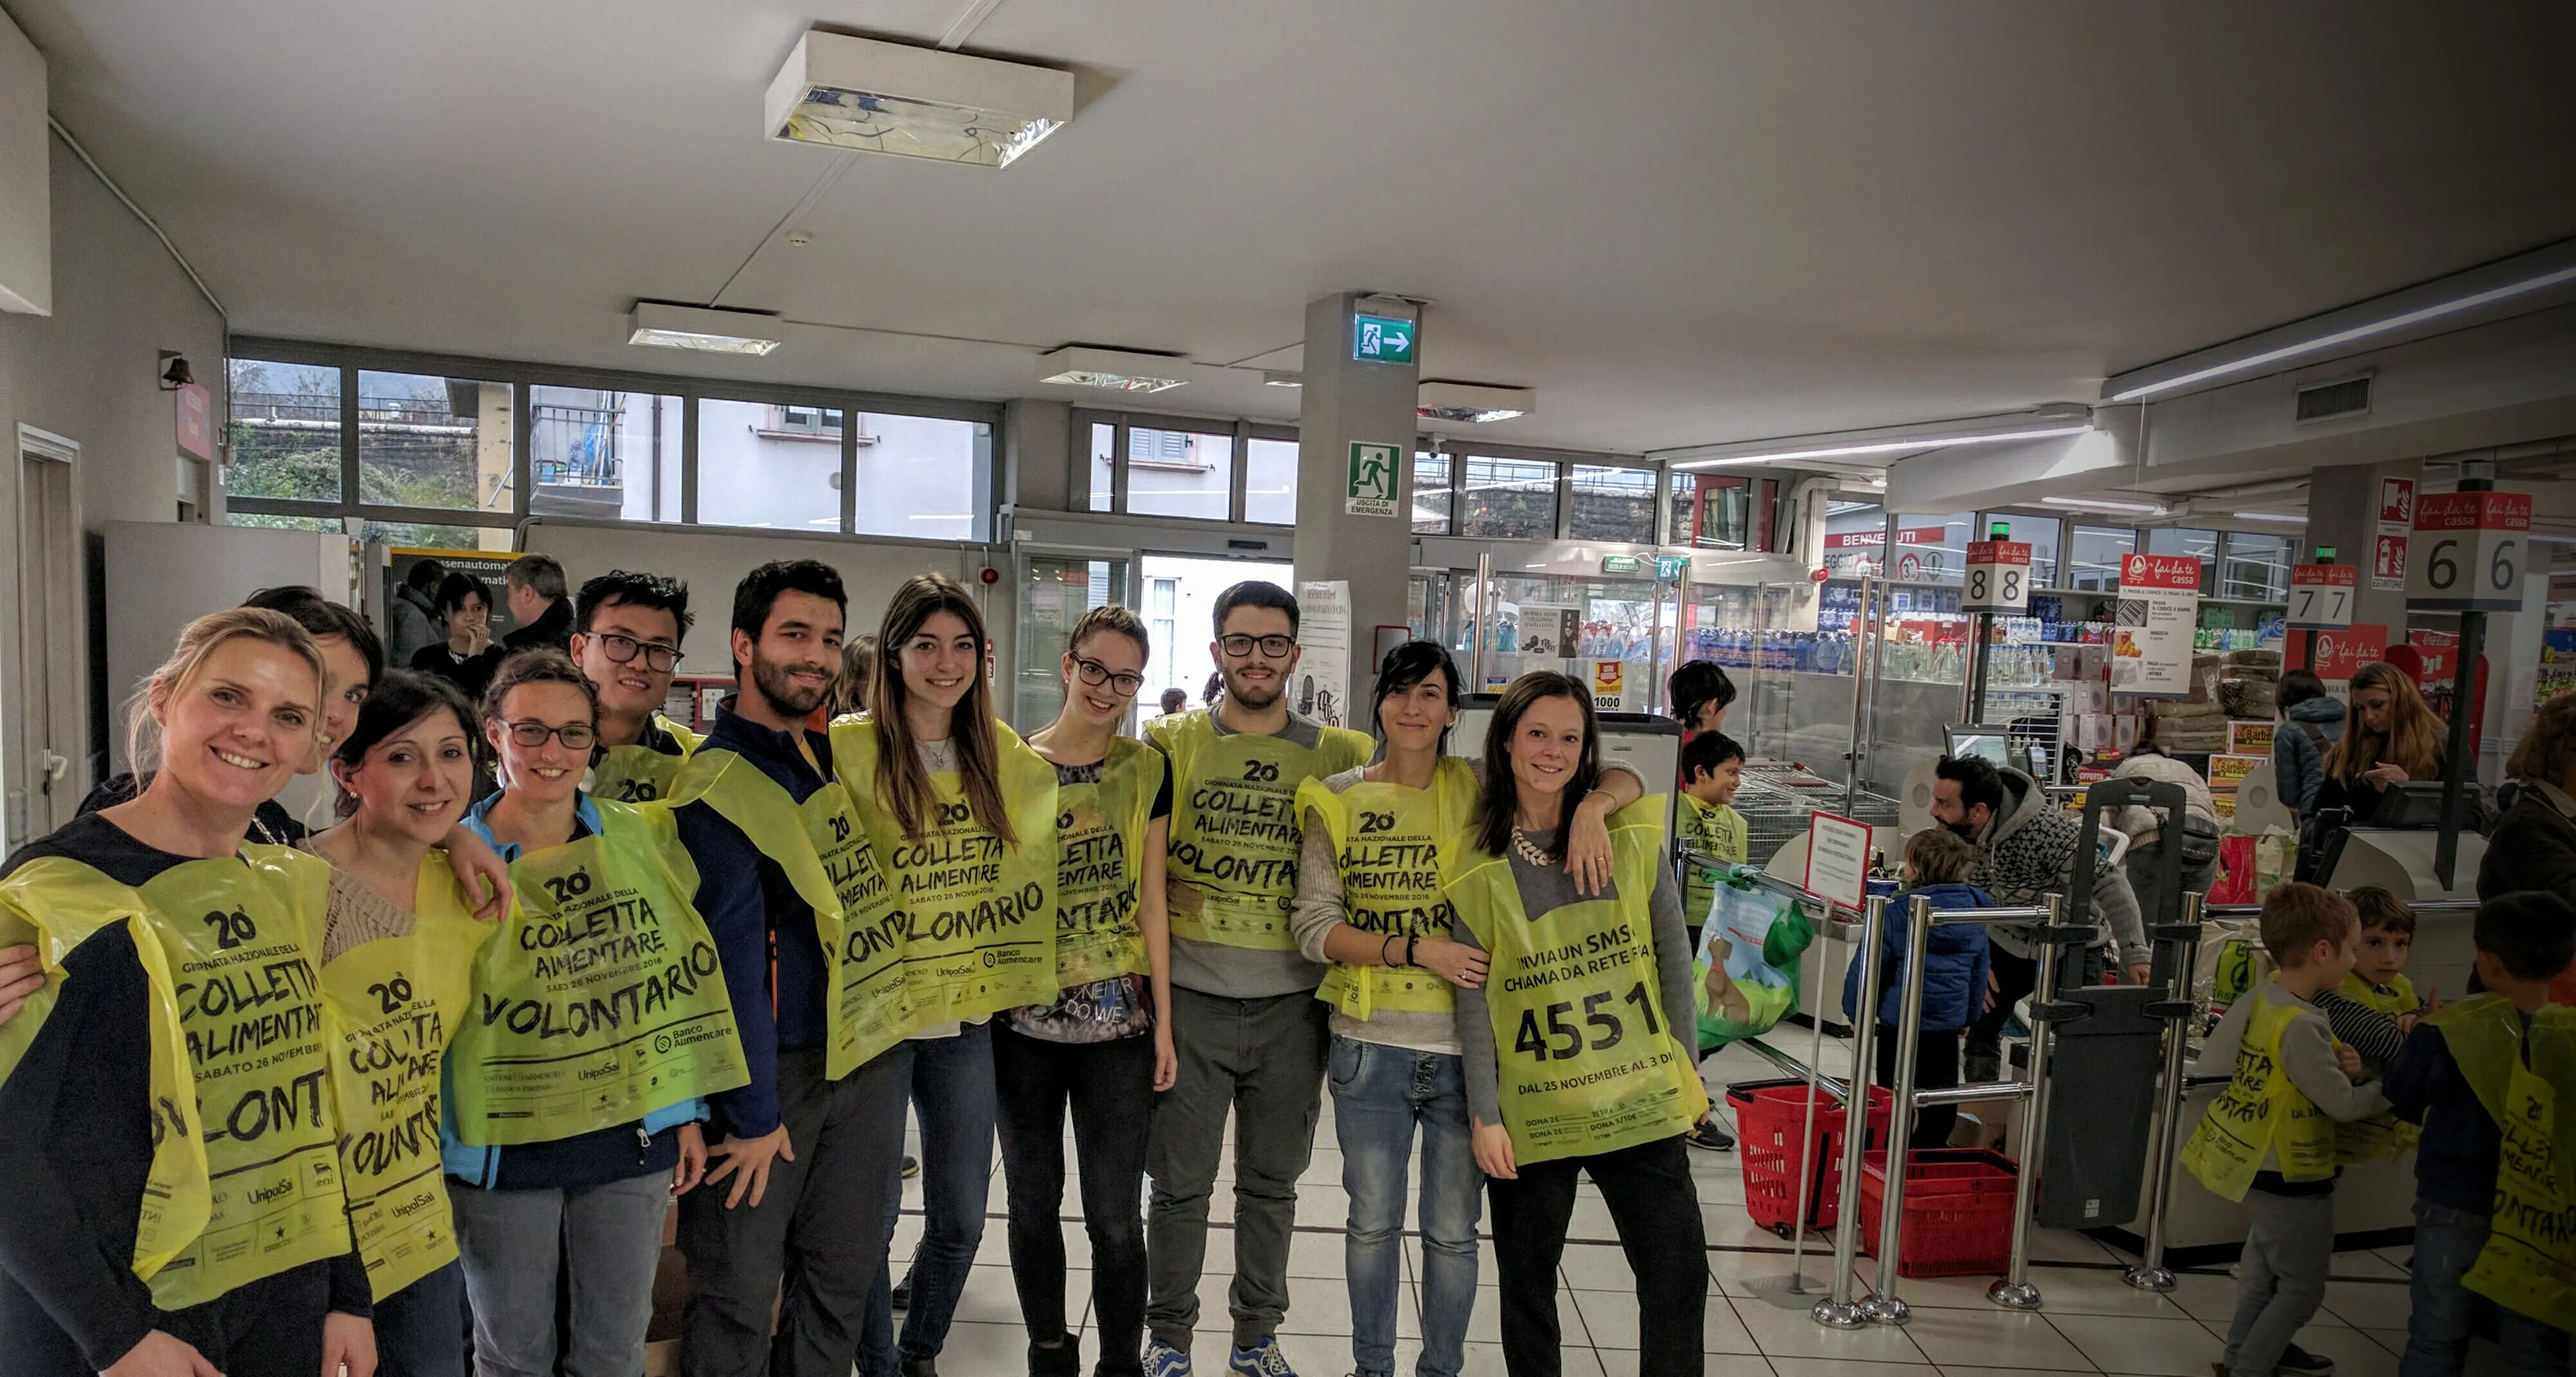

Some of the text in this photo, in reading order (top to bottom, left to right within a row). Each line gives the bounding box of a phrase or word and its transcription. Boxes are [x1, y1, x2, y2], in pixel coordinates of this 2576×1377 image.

[1351, 506, 1393, 515] EMERGENZA
[2445, 516, 2475, 526] cassa
[2505, 518, 2528, 527] cassa
[1843, 531, 1916, 546] BENVEUTI
[2427, 539, 2458, 590] 6
[2491, 540, 2516, 591] 6
[1970, 569, 1986, 600] 8
[2002, 570, 2019, 601] 8
[2171, 575, 2194, 585] cassa
[2372, 578, 2404, 589] ESTINTORE
[2299, 590, 2314, 617] 7
[2332, 592, 2345, 619] 7
[1594, 696, 1620, 707] 1000
[2080, 772, 2104, 780] OFFERTA
[1090, 824, 1114, 834] DELLA
[613, 887, 639, 899] DELLA
[1586, 924, 1631, 954] SMS
[997, 948, 1021, 958] Banco
[998, 955, 1042, 966] Alimentare
[1588, 950, 1630, 975] RETE
[585, 965, 642, 985] NOVEMBRE
[643, 956, 663, 969] 2016
[175, 957, 320, 1024] COLLETTA
[482, 940, 718, 1040] VOLONTARIO
[673, 1024, 703, 1039] Banco
[195, 1061, 253, 1083] SABATO
[256, 1056, 269, 1068] 26
[1518, 1083, 1542, 1095] DAL
[1544, 1081, 1558, 1092] 25
[1560, 1064, 1629, 1090] NOVEMBRE
[1631, 1059, 1648, 1072] AL
[1651, 1056, 1658, 1067] 3
[1525, 1117, 1548, 1127] DONA
[1590, 1120, 1614, 1132] DONA
[1615, 1112, 1638, 1125] 5/10€
[1529, 1129, 1552, 1140] DONA
[316, 1175, 334, 1188] eni
[247, 1178, 293, 1205] UnipolSai
